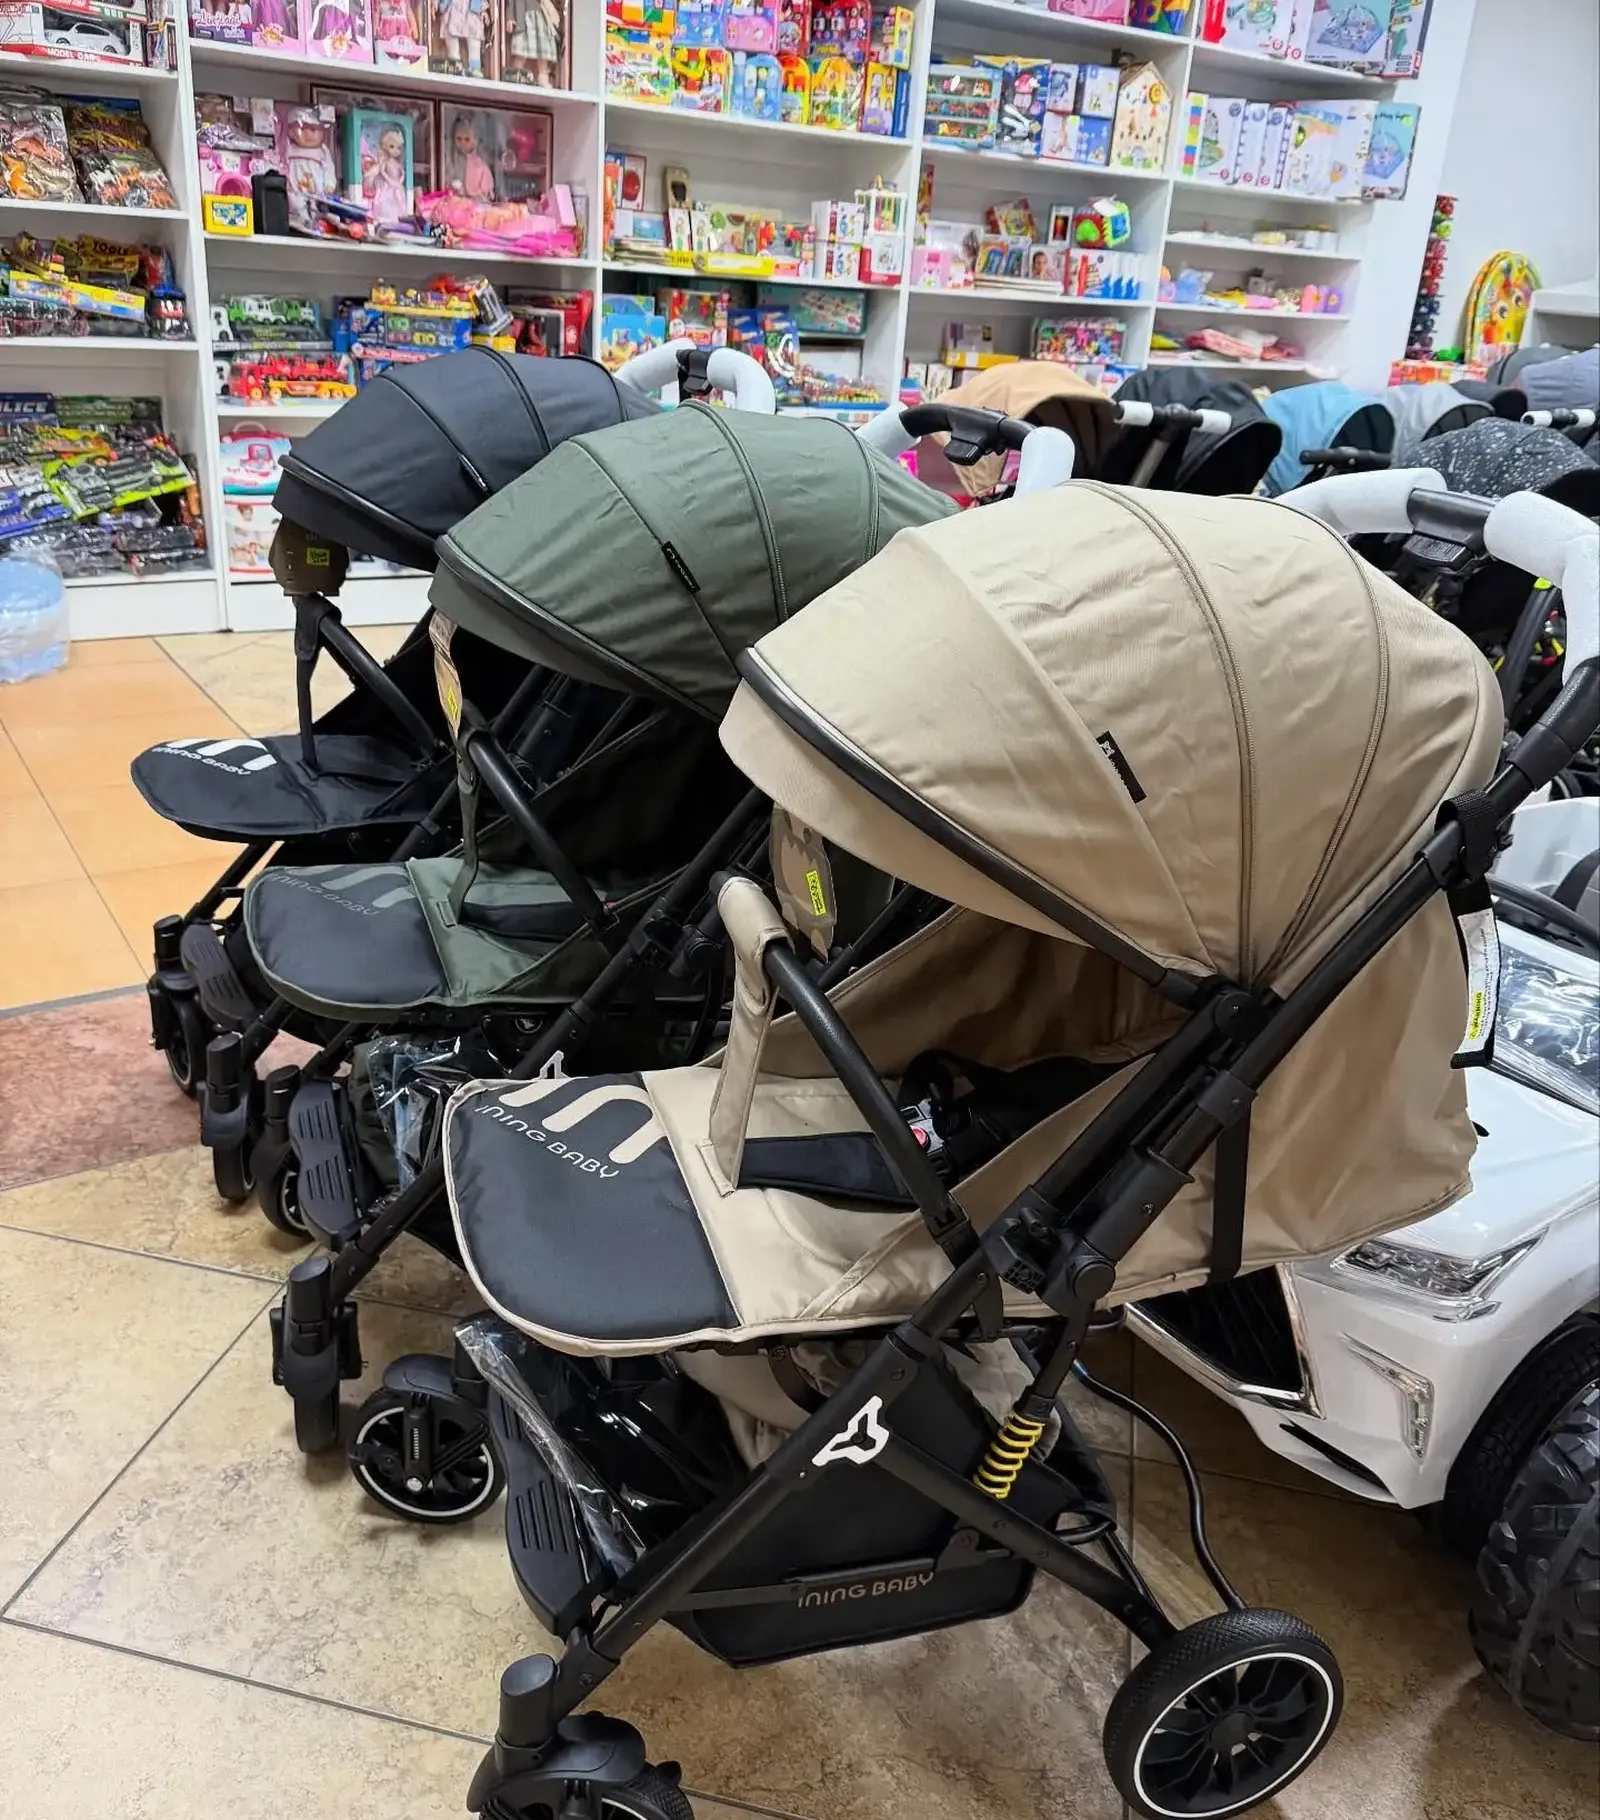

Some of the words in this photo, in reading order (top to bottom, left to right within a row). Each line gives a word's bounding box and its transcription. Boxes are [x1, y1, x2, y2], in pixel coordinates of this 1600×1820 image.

[47, 48, 75, 59] MODEL
[322, 893, 382, 916] BABY
[474, 1105, 547, 1142] INING
[546, 1141, 620, 1179] BABY
[797, 1584, 866, 1608] INING
[871, 1571, 934, 1597] BABY
